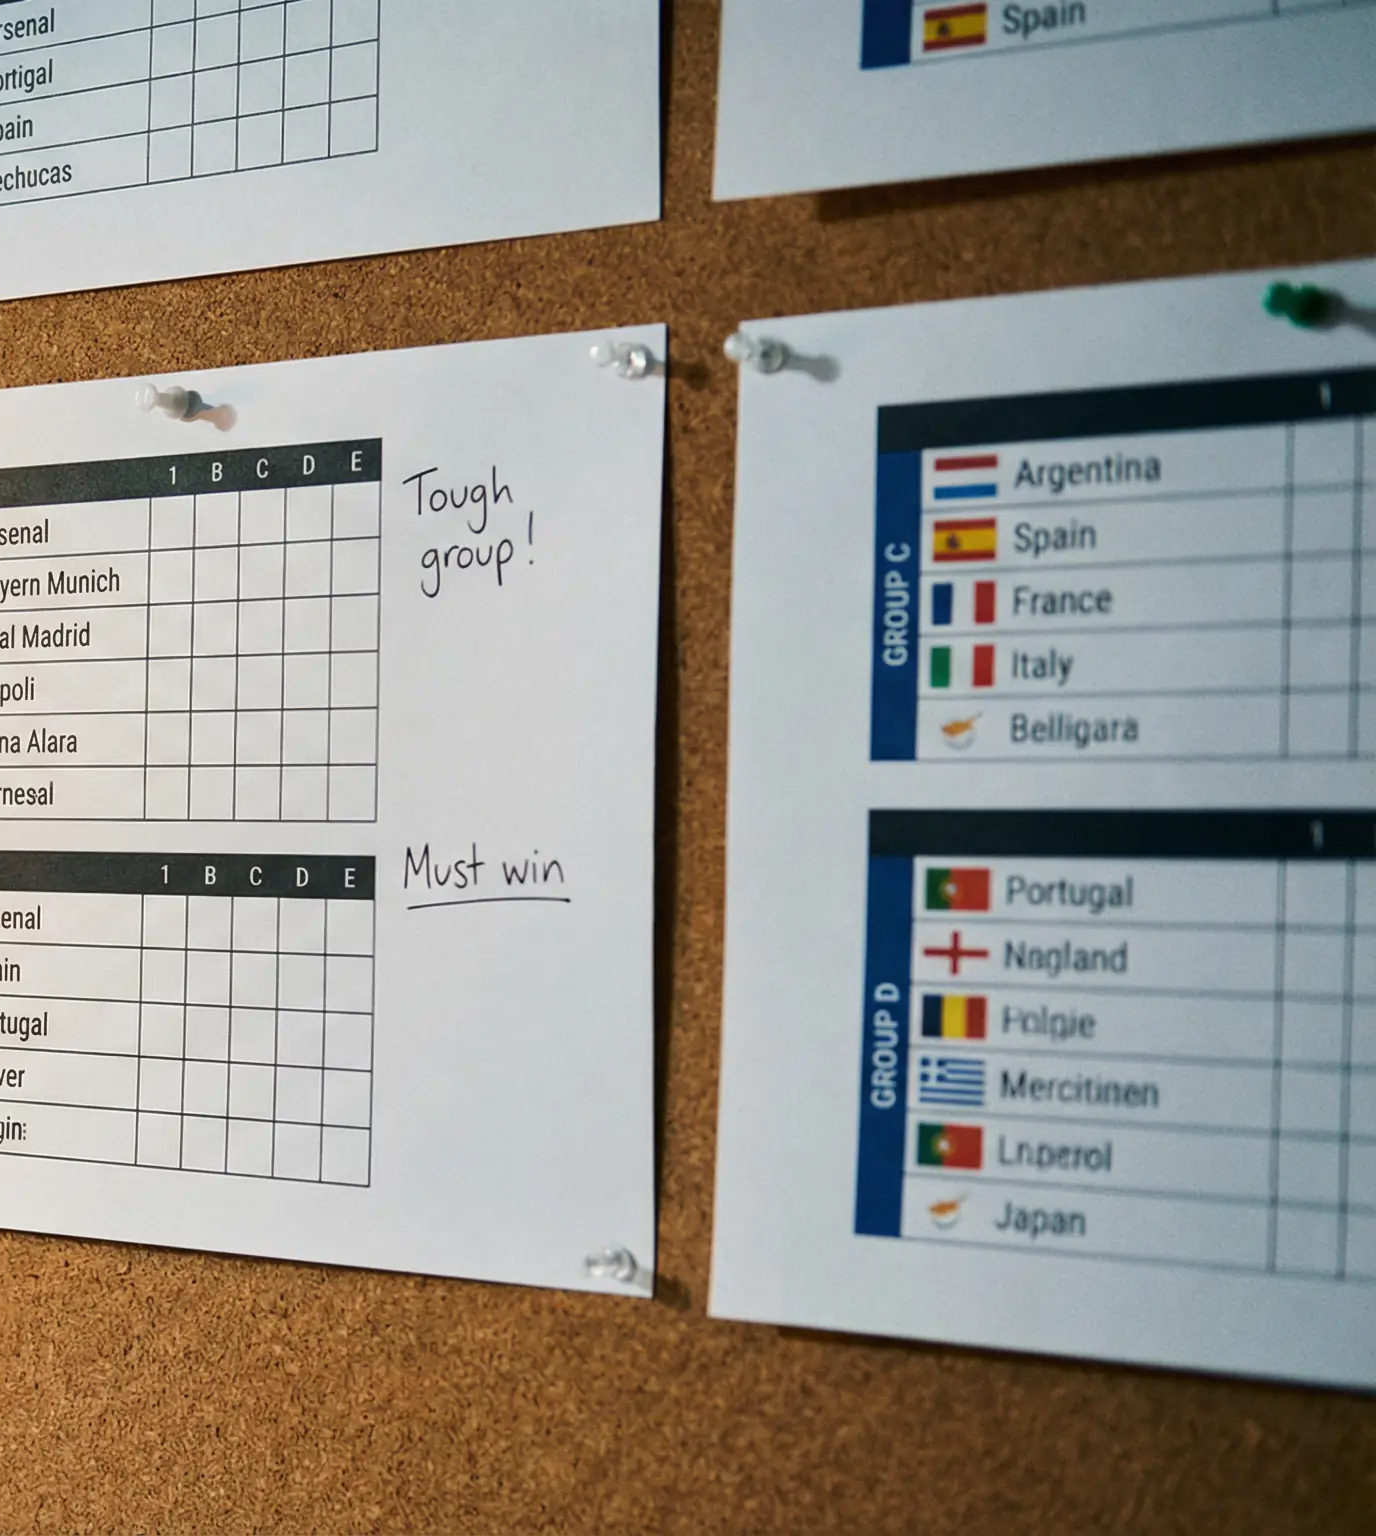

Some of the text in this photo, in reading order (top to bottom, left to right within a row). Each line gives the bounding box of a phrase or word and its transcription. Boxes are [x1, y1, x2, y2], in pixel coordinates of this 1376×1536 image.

[1002, 0, 1087, 40] Spain
[171, 452, 363, 485] 1 B C D E
[1014, 453, 1162, 495] Argentina
[404, 467, 514, 535] Tough
[420, 511, 535, 599] group!
[1015, 523, 1097, 559] Spain
[49, 568, 120, 596] Munich
[1014, 586, 1114, 616] France
[884, 543, 911, 667] GROUP C
[23, 623, 91, 649] Madrid
[1013, 650, 1074, 688] Italy
[28, 729, 78, 754] Alara
[1011, 714, 1140, 750] Belligara
[163, 866, 356, 889] 1 B C D E
[405, 844, 565, 890] Must win
[1007, 876, 1134, 916] Portugal
[872, 984, 901, 1109] GROUP D
[995, 1202, 1087, 1241] Japan
